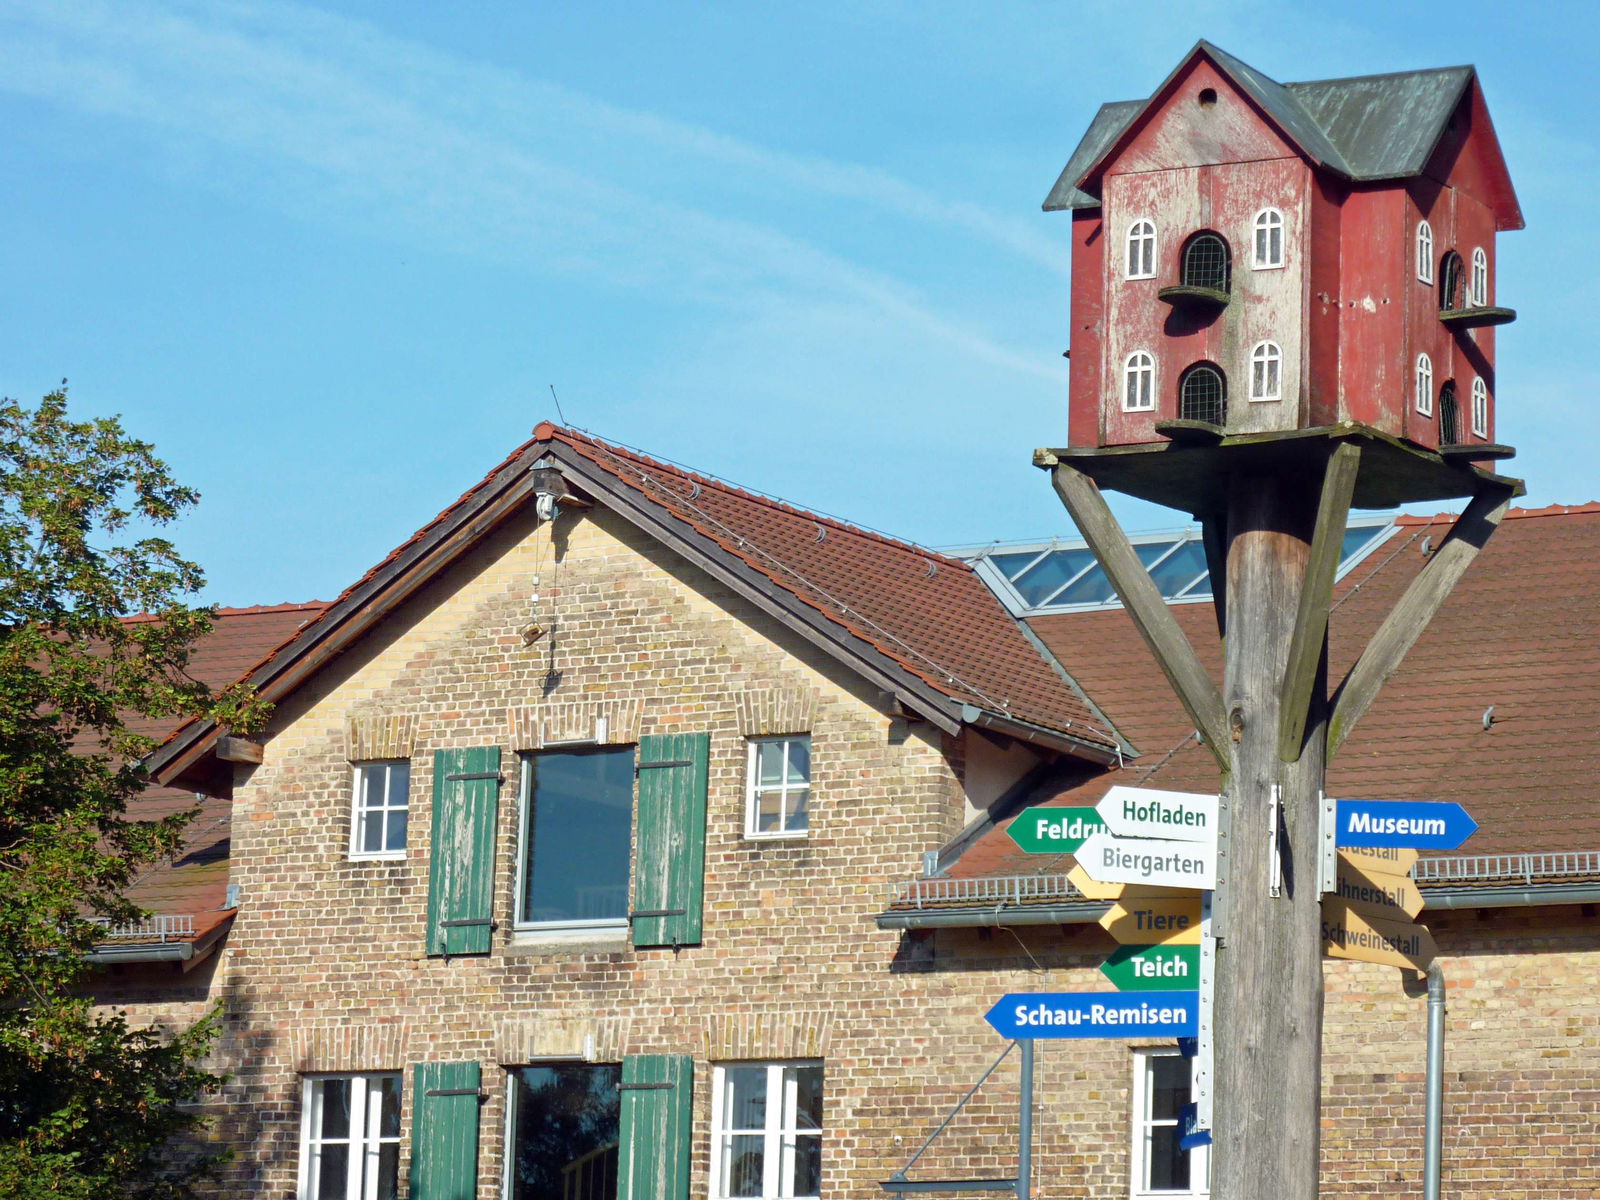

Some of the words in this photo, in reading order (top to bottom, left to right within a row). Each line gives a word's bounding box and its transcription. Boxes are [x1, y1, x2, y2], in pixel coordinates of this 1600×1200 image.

[1123, 800, 1206, 827] Hofladen
[1348, 812, 1446, 835] Museum
[1036, 817, 1107, 839] Feldru
[1103, 848, 1205, 876] Biergarten
[1134, 910, 1189, 930] Tiere
[1322, 922, 1419, 956] Schweinestall
[1131, 955, 1188, 977] Teich
[1015, 1003, 1187, 1026] Schau-Remisen
